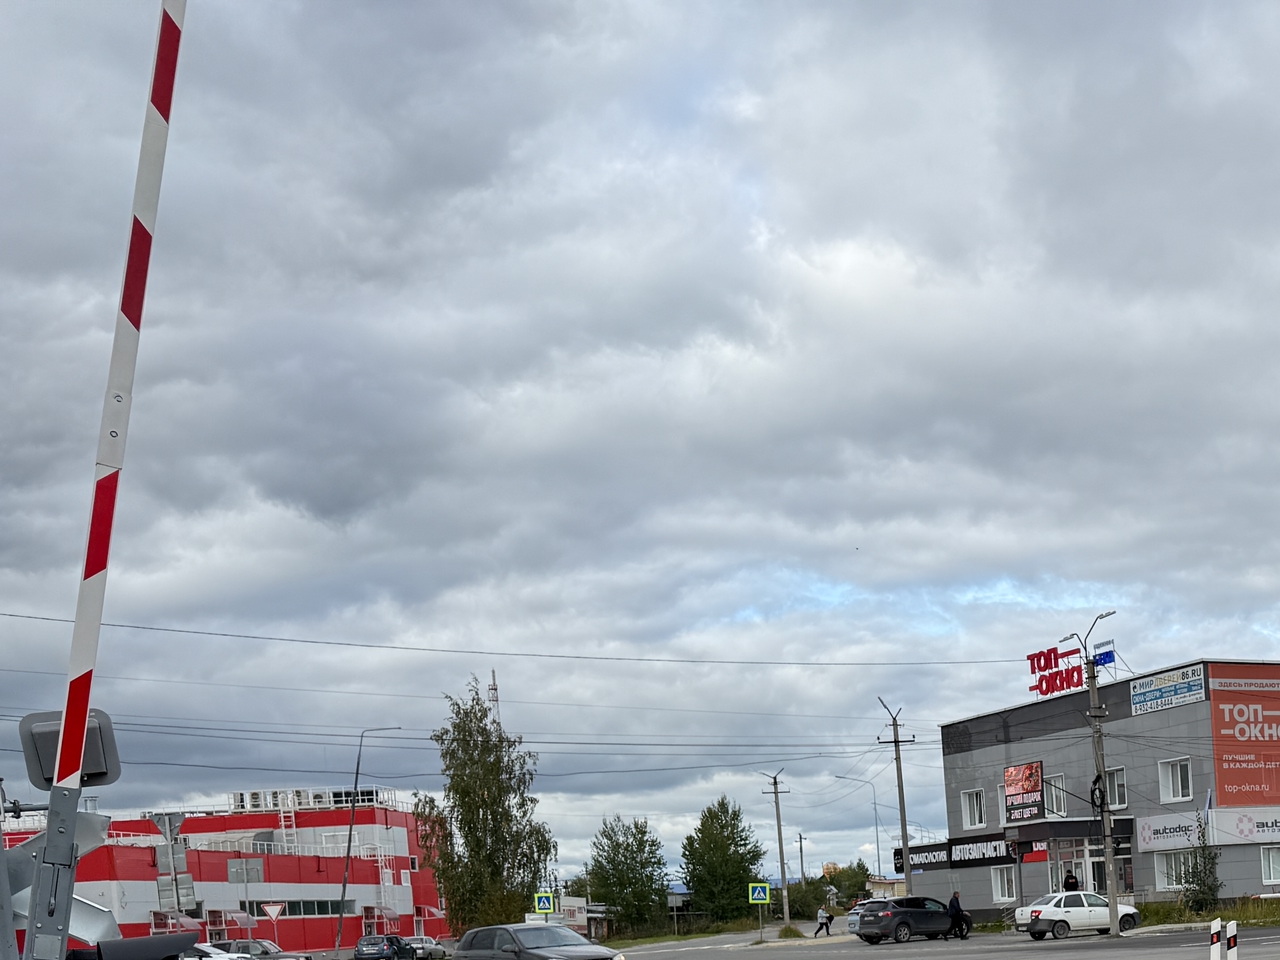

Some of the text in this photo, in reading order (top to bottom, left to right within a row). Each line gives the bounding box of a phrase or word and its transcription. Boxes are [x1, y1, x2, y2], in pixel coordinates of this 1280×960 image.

[1230, 761, 1265, 769] КАЖДОЙ
[1224, 783, 1270, 793] top-okna.ru
[952, 840, 1007, 861] АВТОЗАПЧАСТИ
